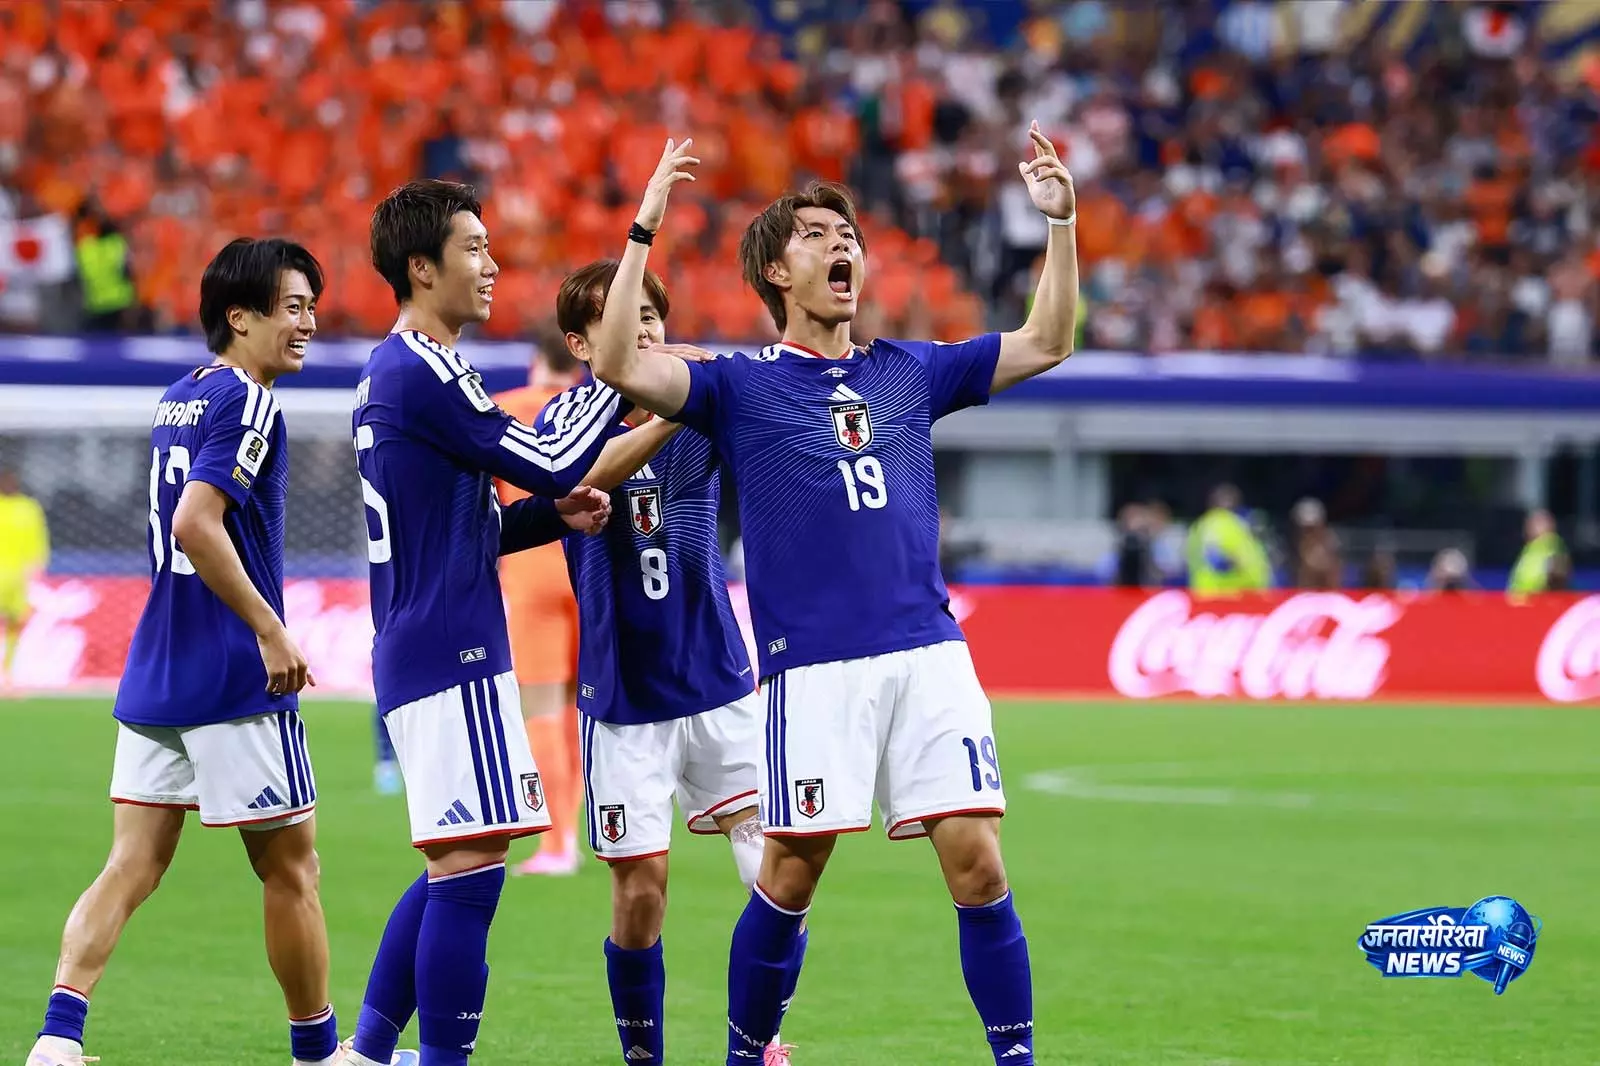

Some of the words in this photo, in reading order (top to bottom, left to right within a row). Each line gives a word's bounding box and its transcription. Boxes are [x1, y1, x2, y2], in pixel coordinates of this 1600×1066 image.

[837, 455, 888, 512] 19
[640, 548, 669, 600] 8
[963, 735, 1000, 791] 19
